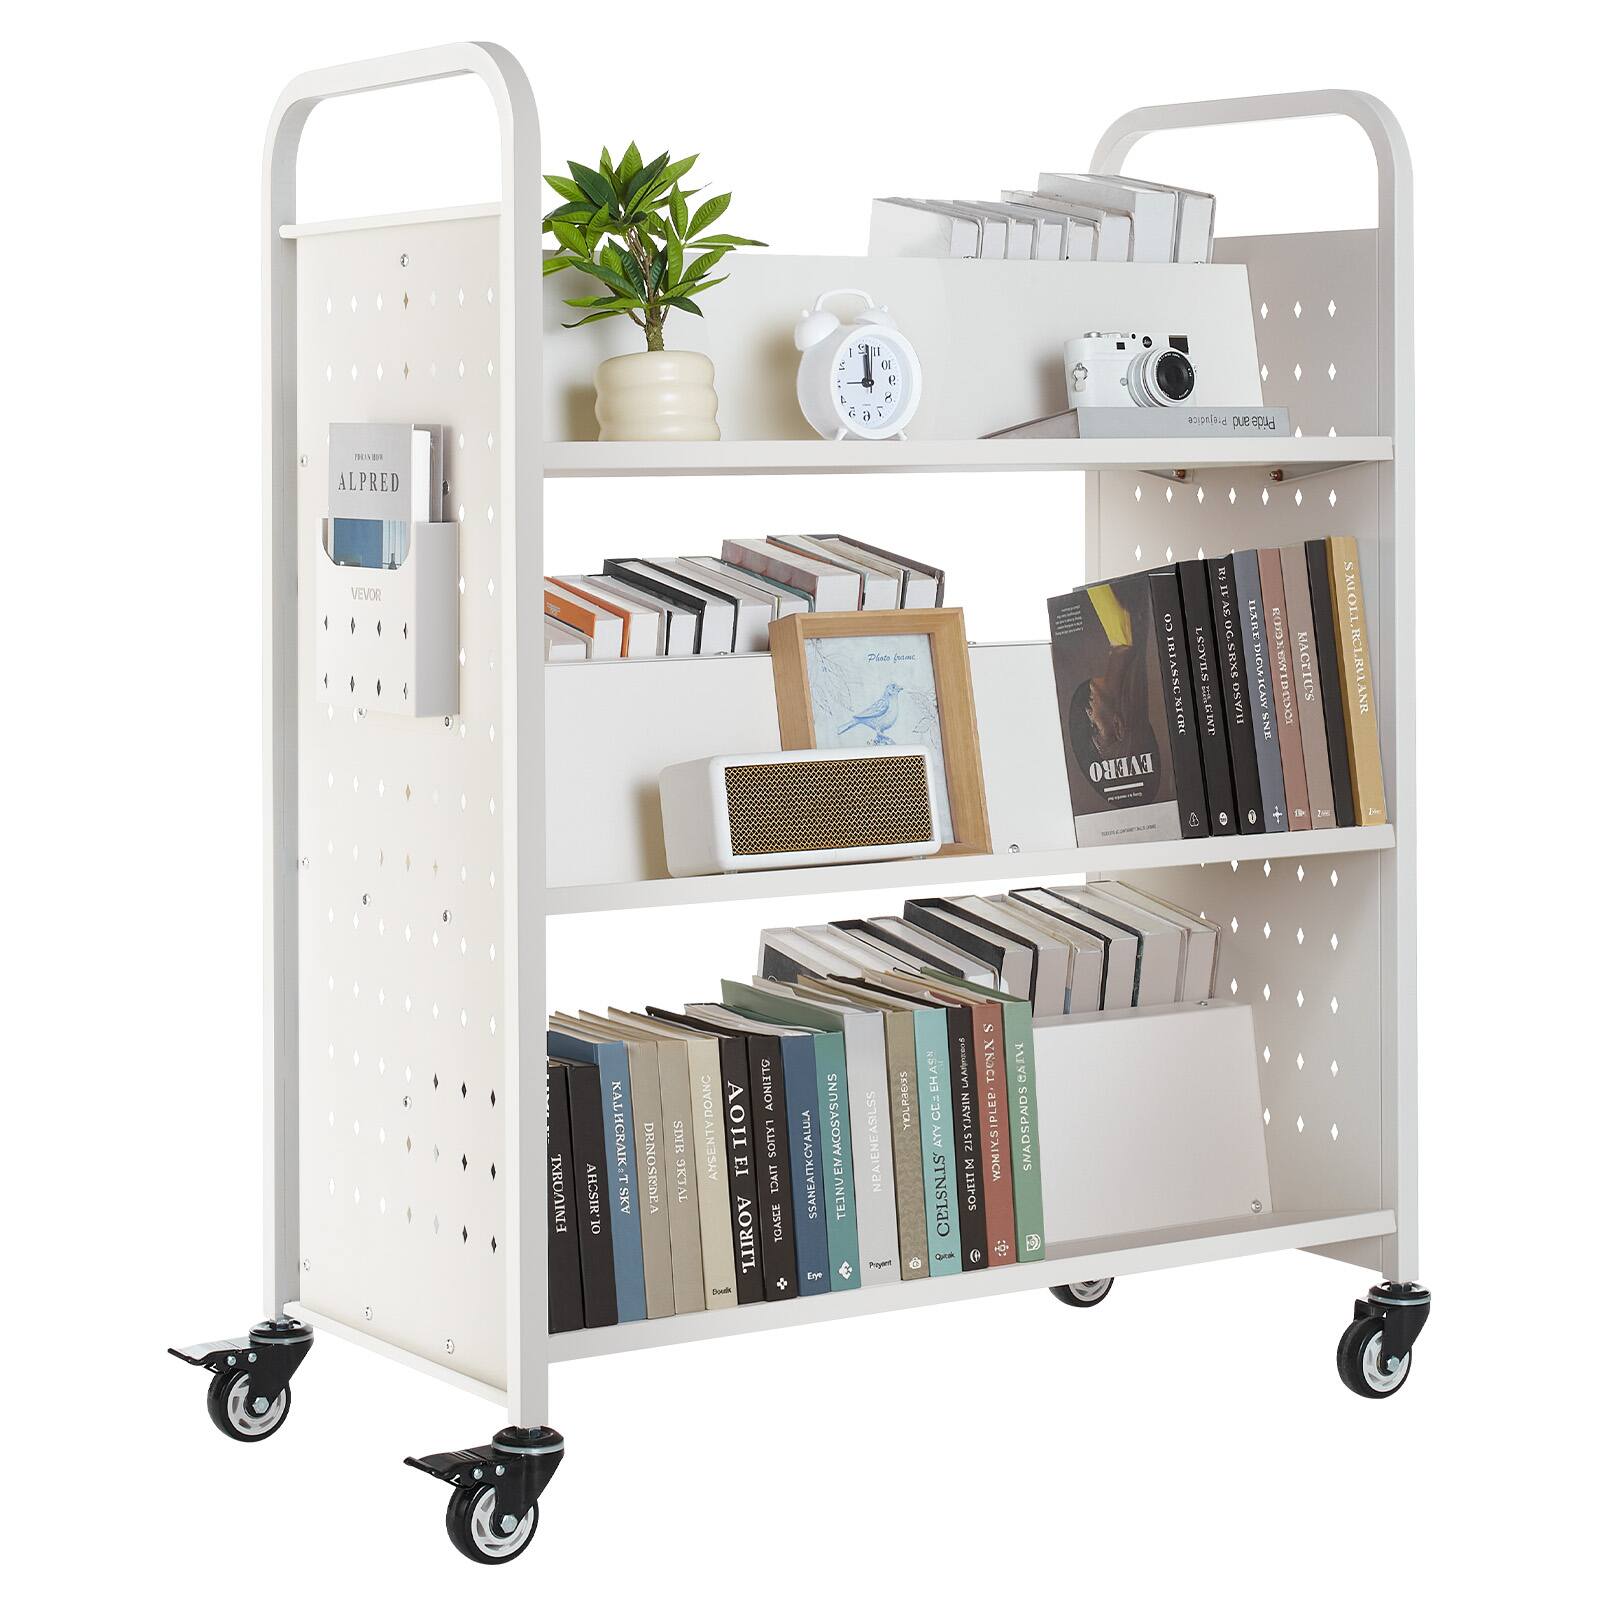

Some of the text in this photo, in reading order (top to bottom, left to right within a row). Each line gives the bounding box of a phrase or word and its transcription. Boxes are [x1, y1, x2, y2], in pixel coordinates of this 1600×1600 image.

[1188, 414, 1276, 430] Pride and Prejudice
[338, 471, 400, 492] ALPRED
[351, 586, 382, 601] VEVOR
[868, 652, 891, 663] Photo
[1089, 752, 1153, 783] EVERO
